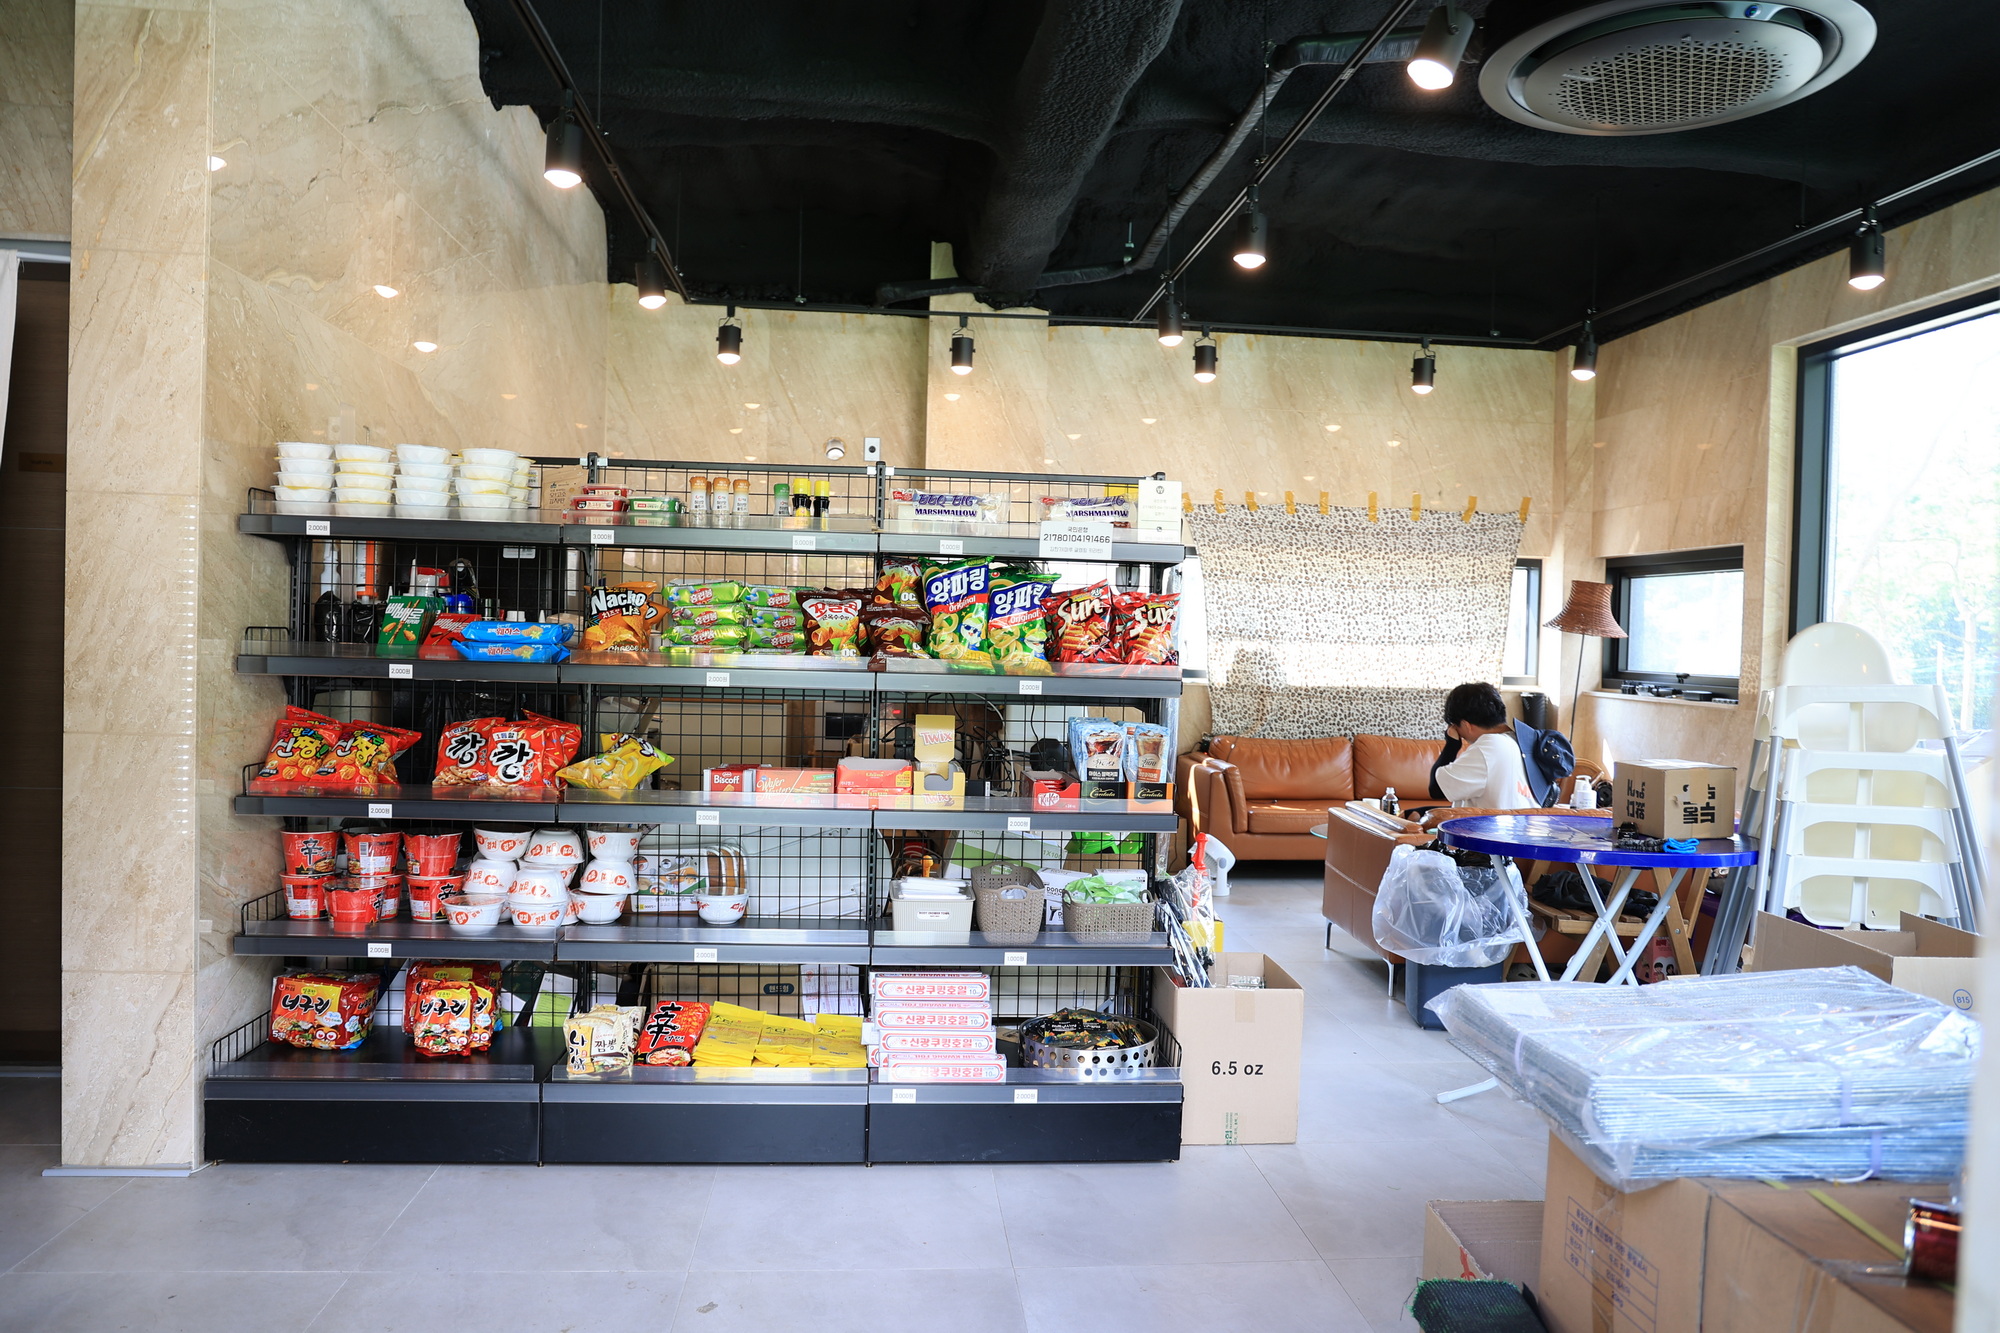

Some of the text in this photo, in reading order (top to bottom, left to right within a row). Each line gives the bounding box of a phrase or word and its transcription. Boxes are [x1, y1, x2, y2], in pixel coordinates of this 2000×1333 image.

[915, 508, 977, 517] MARSHMALLOW
[1043, 533, 1111, 543] 21780104191466
[931, 567, 985, 603] 양파링
[591, 589, 646, 616] Nacho
[949, 595, 976, 612] Original
[994, 584, 1047, 614] 양파링
[1010, 610, 1039, 624] Original
[1057, 599, 1103, 637] Sun
[920, 731, 953, 745] Twix
[446, 732, 485, 767] 깡
[491, 740, 531, 781] 깡
[713, 775, 740, 784] Biscoff
[757, 778, 785, 791] Wafer
[1089, 787, 1116, 798] Cantata
[1137, 787, 1163, 798] Cantata
[301, 837, 323, 866] 辛
[905, 985, 967, 995] 신광쿠킹호일
[282, 994, 331, 1015] 너구리
[419, 997, 468, 1017] 너구리
[647, 1002, 684, 1048] 辛
[905, 1015, 969, 1026] 신광쿠킹호일
[594, 1038, 617, 1052] 짬뽕
[909, 1038, 973, 1048] 신광쿠킹호일
[1211, 1061, 1264, 1075] 6.5 oz
